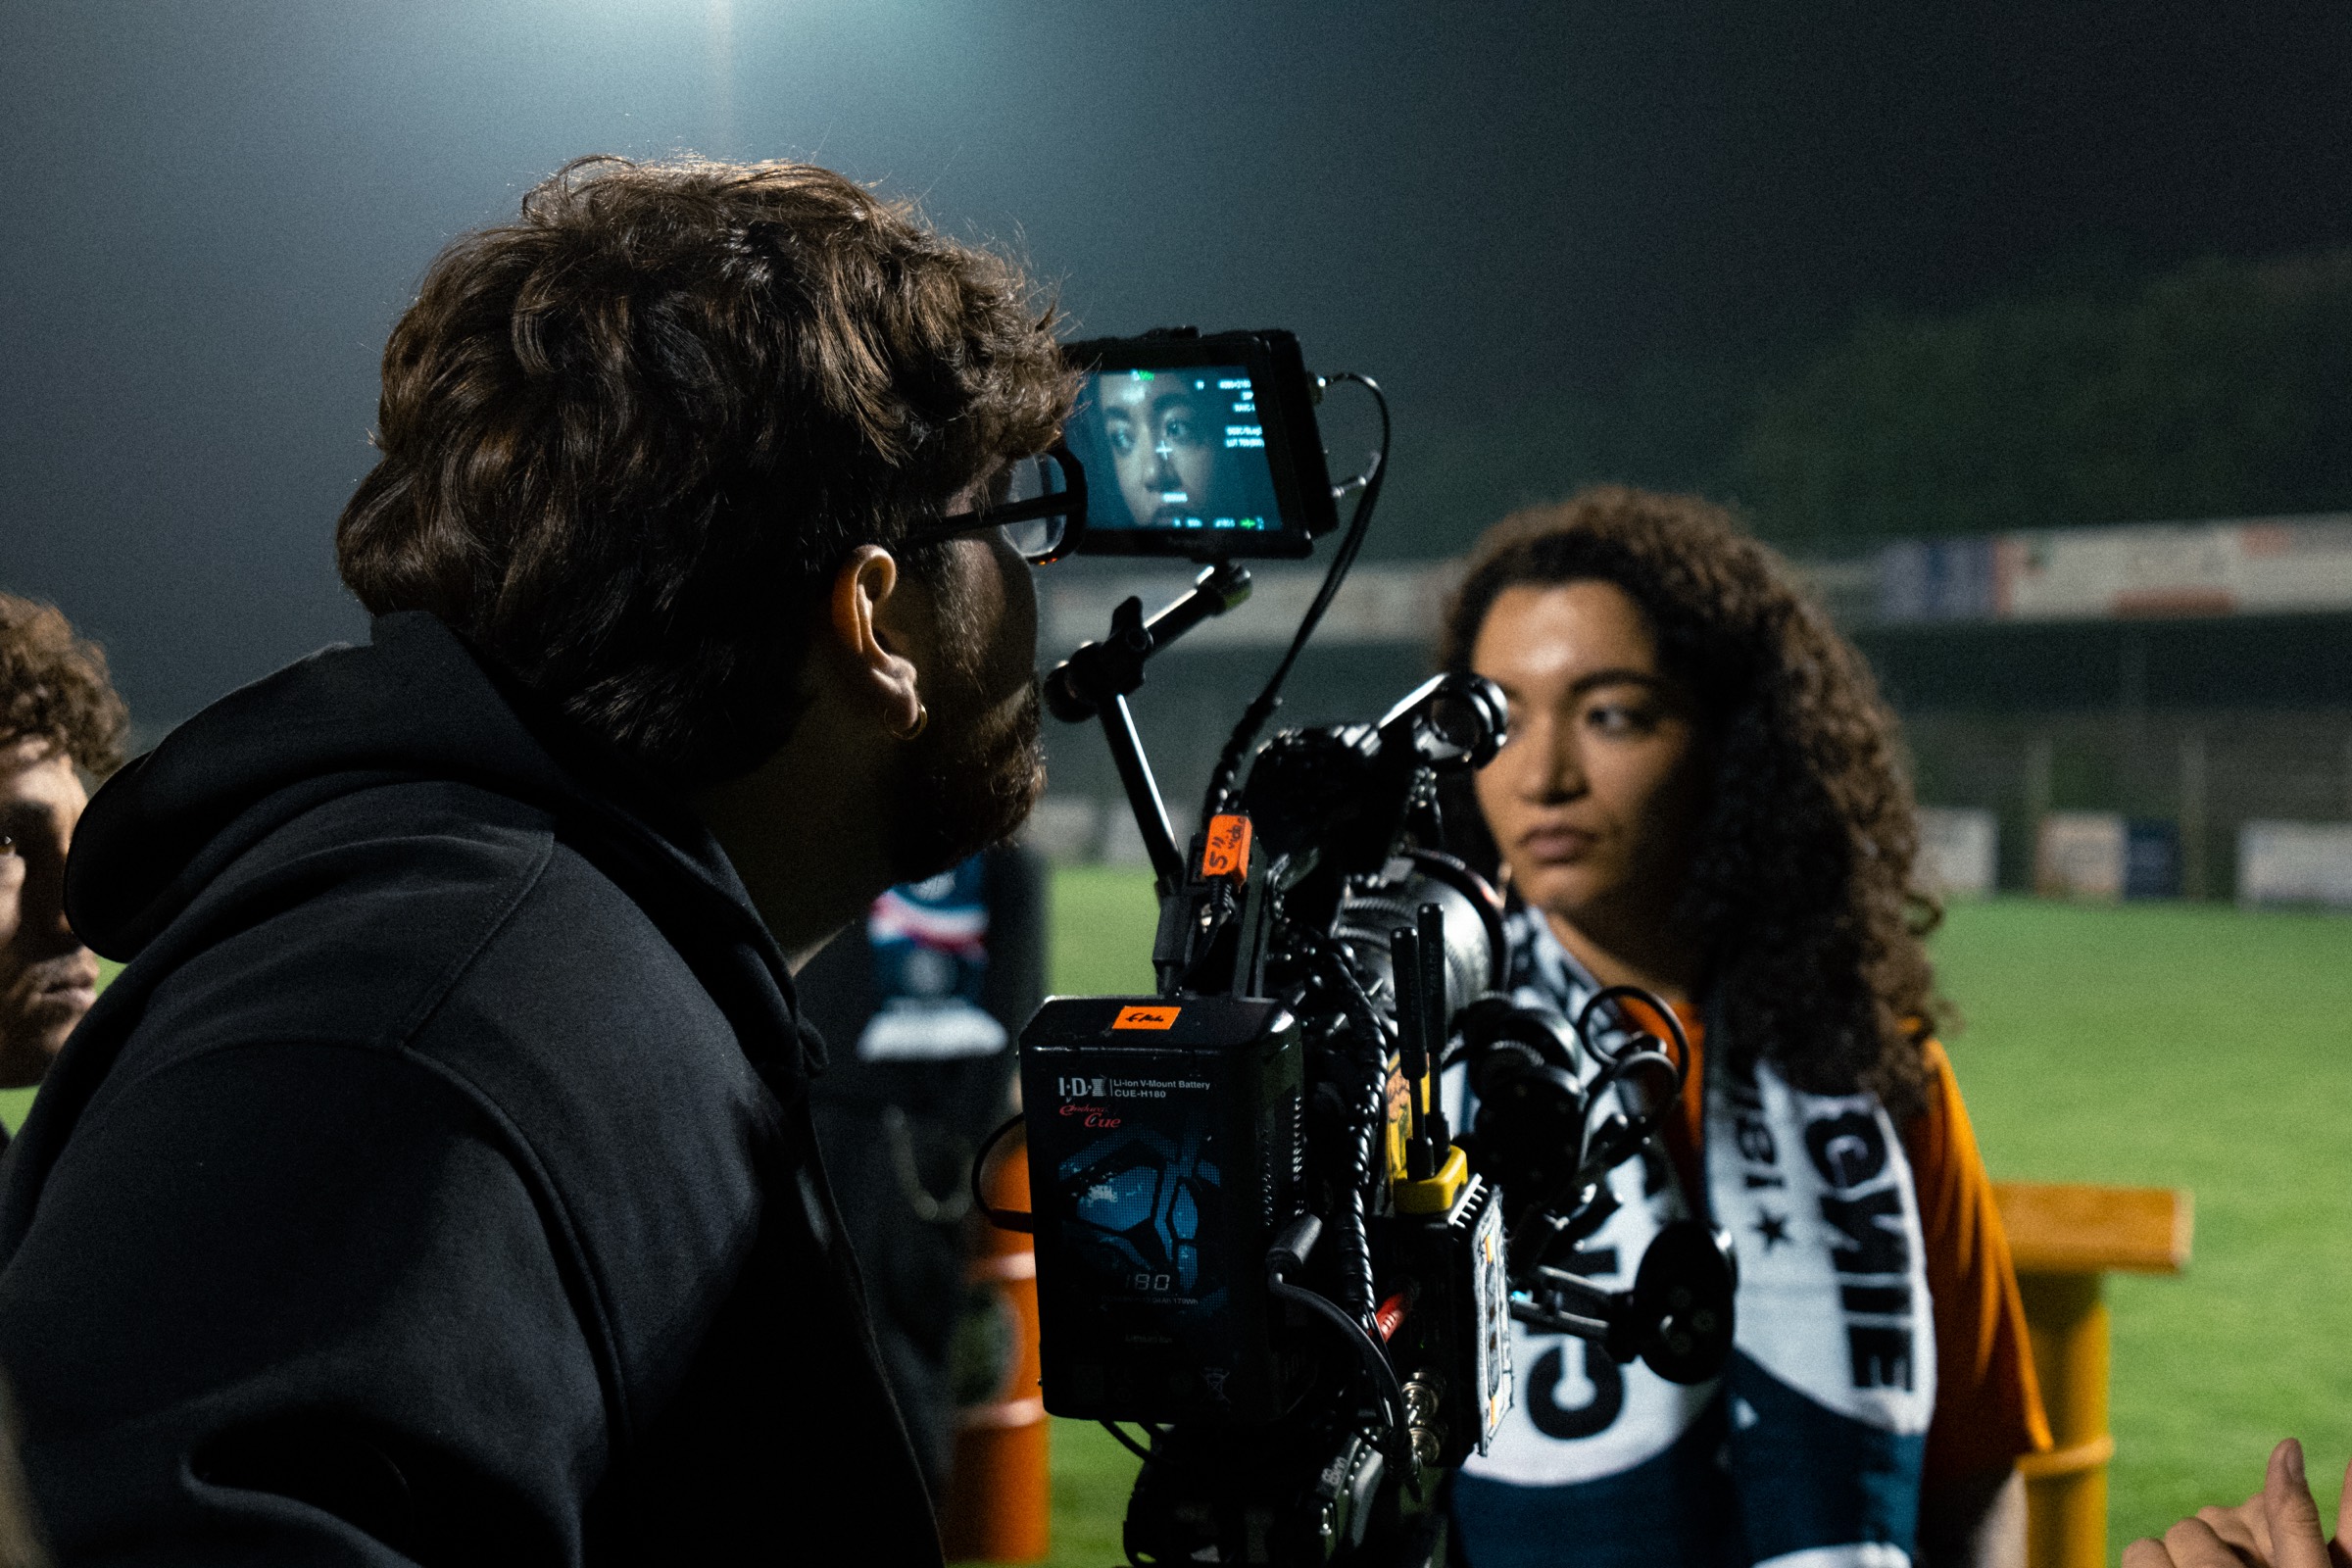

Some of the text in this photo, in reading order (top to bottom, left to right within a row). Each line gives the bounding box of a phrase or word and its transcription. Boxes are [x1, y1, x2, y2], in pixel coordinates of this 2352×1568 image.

[1178, 1080, 1210, 1091] Battery
[1114, 1089, 1166, 1098] CUE-H180
[1083, 1112, 1122, 1129] Cue
